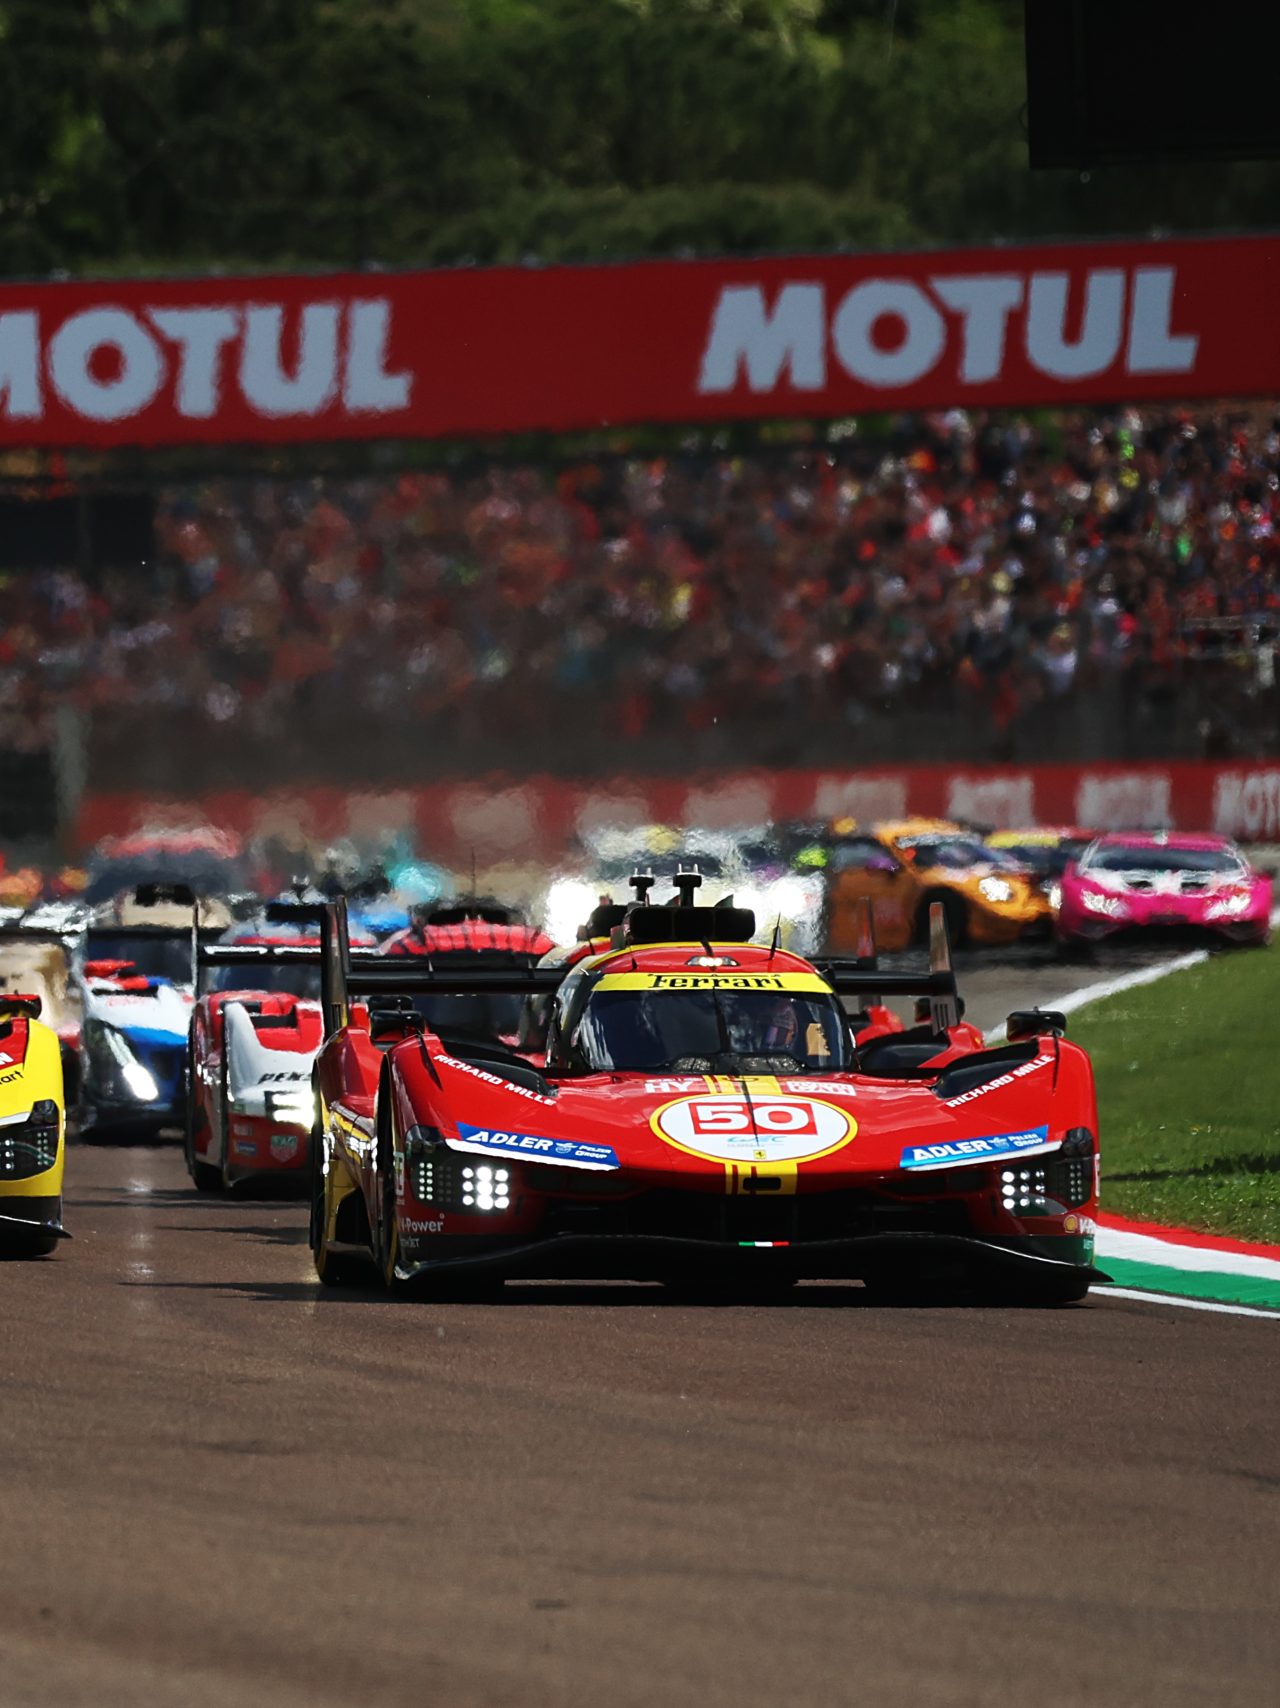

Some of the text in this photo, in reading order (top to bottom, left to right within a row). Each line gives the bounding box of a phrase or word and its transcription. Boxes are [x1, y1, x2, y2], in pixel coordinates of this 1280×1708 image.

[698, 267, 1199, 394] MOTUL
[647, 974, 787, 989] Ferrari
[433, 1054, 557, 1106] RICHARD MILLE
[644, 1081, 694, 1093] HY
[945, 1054, 1055, 1108] RICHARD MILLE
[695, 1104, 809, 1131] 50
[466, 1131, 554, 1151] ADLER
[912, 1139, 993, 1162] ADLER
[574, 1150, 608, 1159] GROUP
